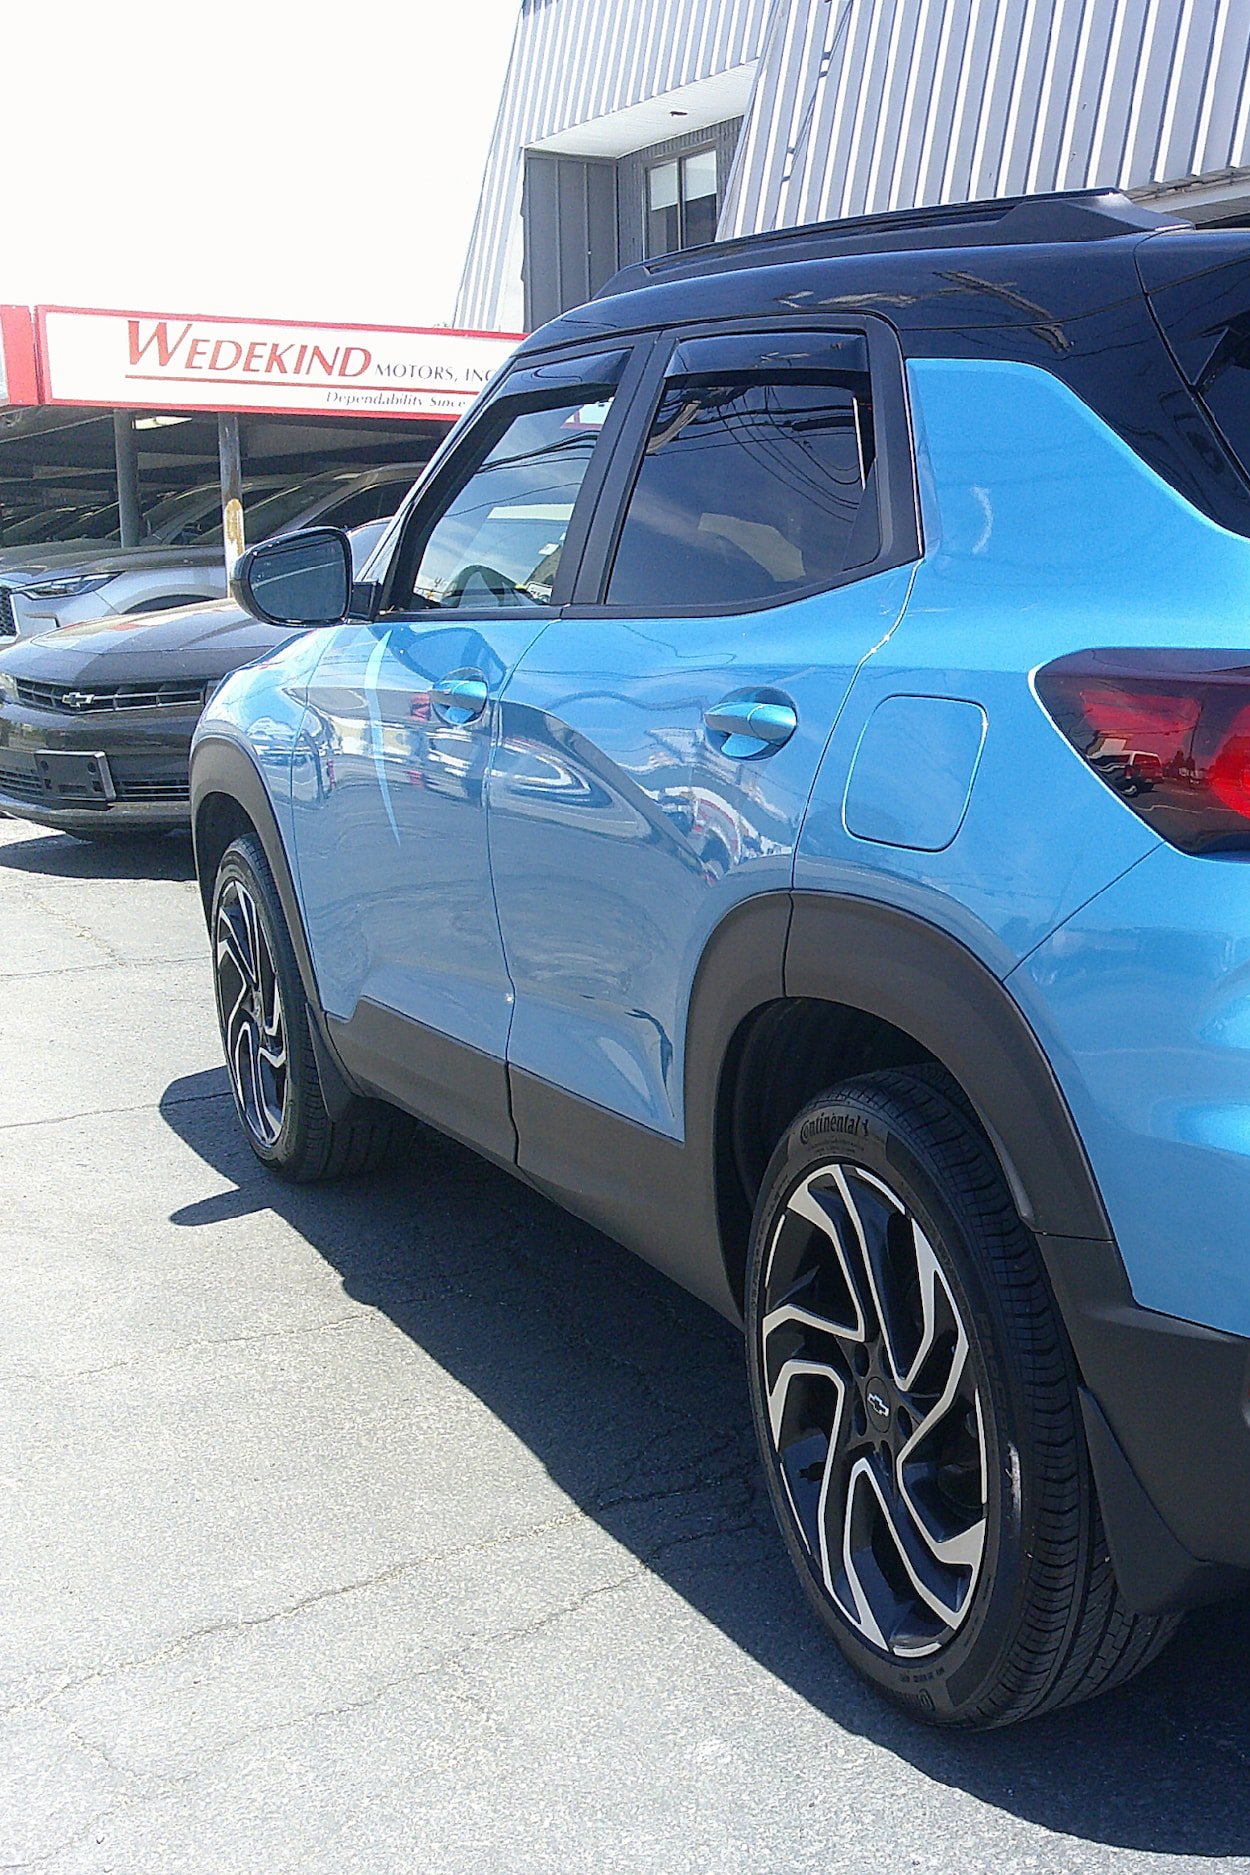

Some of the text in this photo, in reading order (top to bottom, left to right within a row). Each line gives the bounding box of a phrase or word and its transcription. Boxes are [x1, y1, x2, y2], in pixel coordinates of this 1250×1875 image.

[374, 363, 458, 383] MOTORS,
[326, 391, 467, 408] Dependability Since
